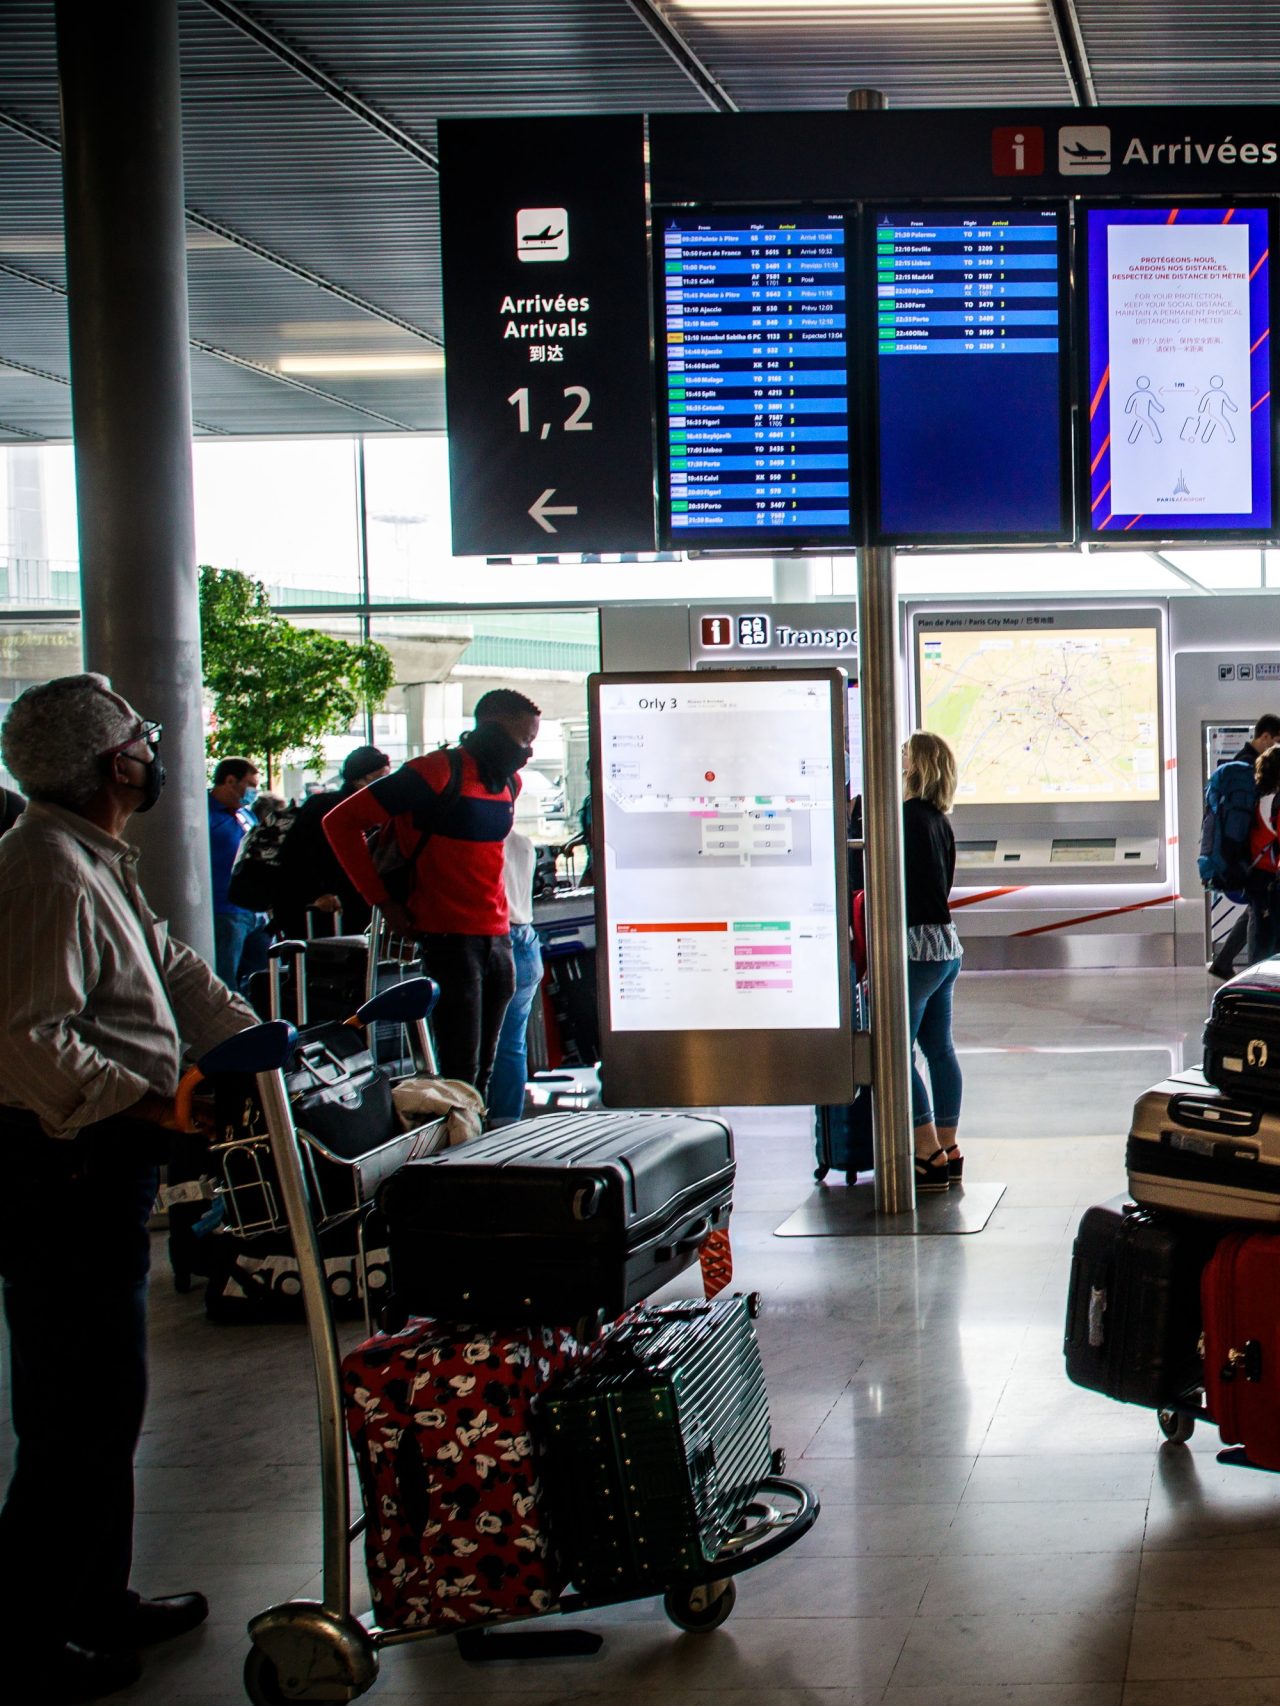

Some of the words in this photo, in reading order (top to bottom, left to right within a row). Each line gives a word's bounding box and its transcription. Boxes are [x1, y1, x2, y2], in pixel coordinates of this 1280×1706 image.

[1122, 136, 1277, 164] Arrivées
[500, 294, 590, 314] Arrivées
[700, 306, 722, 314] Ajaccio
[504, 318, 588, 338] Arrivals
[530, 345, 564, 362] 到达
[918, 619, 933, 627] Plan
[935, 619, 944, 627] de
[969, 618, 985, 626] Paris
[987, 618, 1001, 627] City
[1003, 618, 1019, 627] Map
[639, 698, 666, 712] Orly
[670, 698, 677, 709] 3
